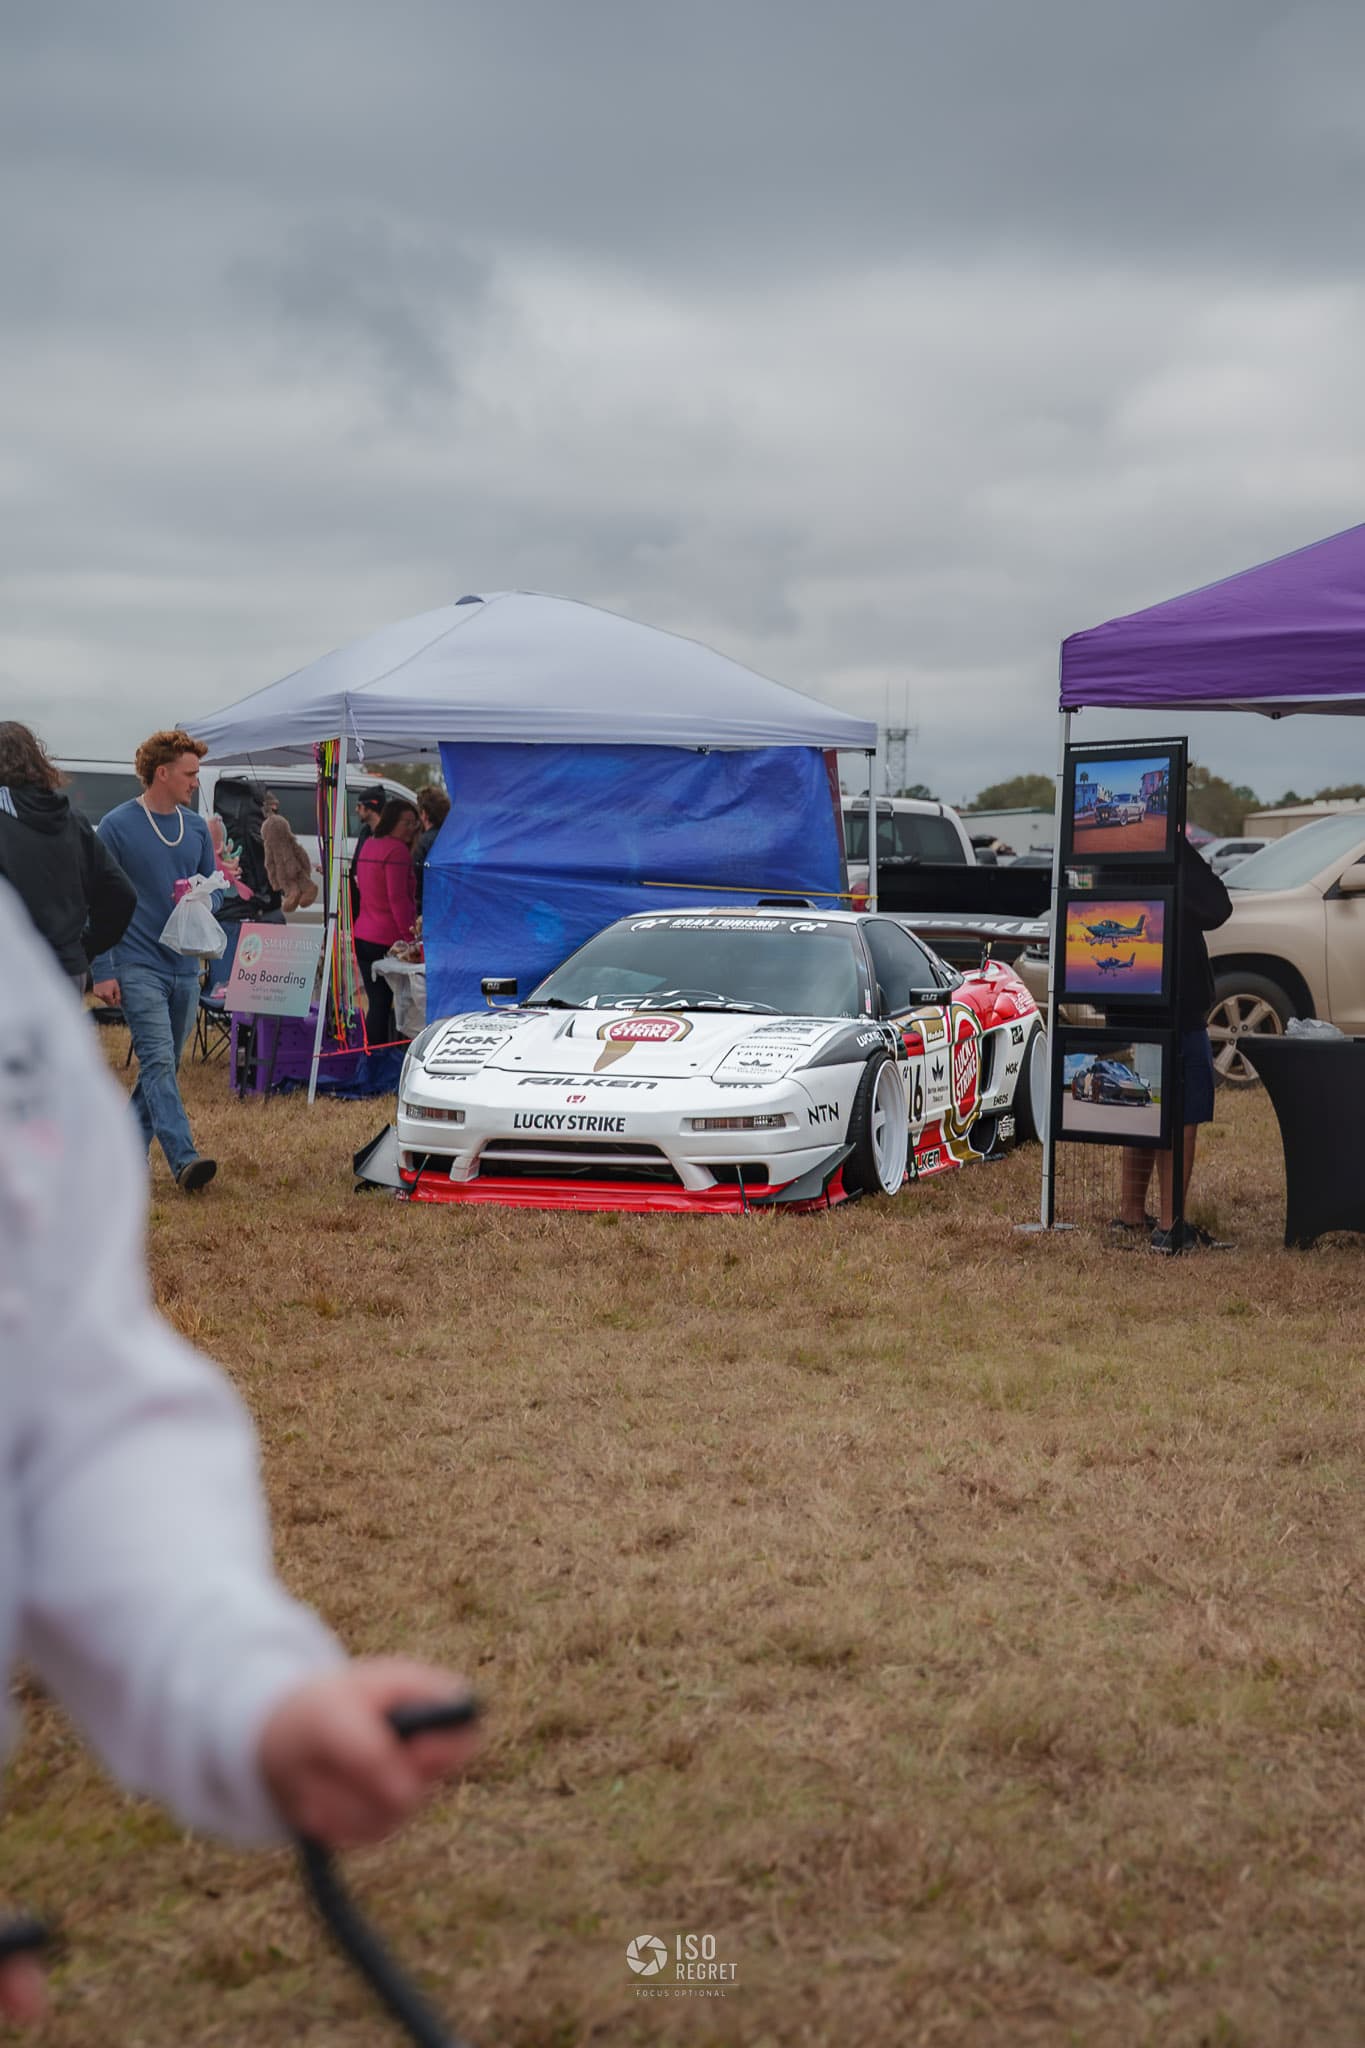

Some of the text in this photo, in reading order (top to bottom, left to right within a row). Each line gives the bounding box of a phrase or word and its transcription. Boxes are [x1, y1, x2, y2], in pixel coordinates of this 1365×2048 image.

[671, 918, 713, 927] GRAN
[237, 969, 306, 989] Dog Boarding
[611, 1027, 673, 1038] STRIKE
[620, 1023, 676, 1032] LUCKY
[445, 1036, 503, 1045] NGK
[1005, 1062, 1019, 1076] NGK
[517, 1077, 658, 1090] FALKEN
[908, 1064, 924, 1123] 16
[807, 1101, 840, 1126] NTN
[513, 1113, 626, 1133] LUCKY STRIKE
